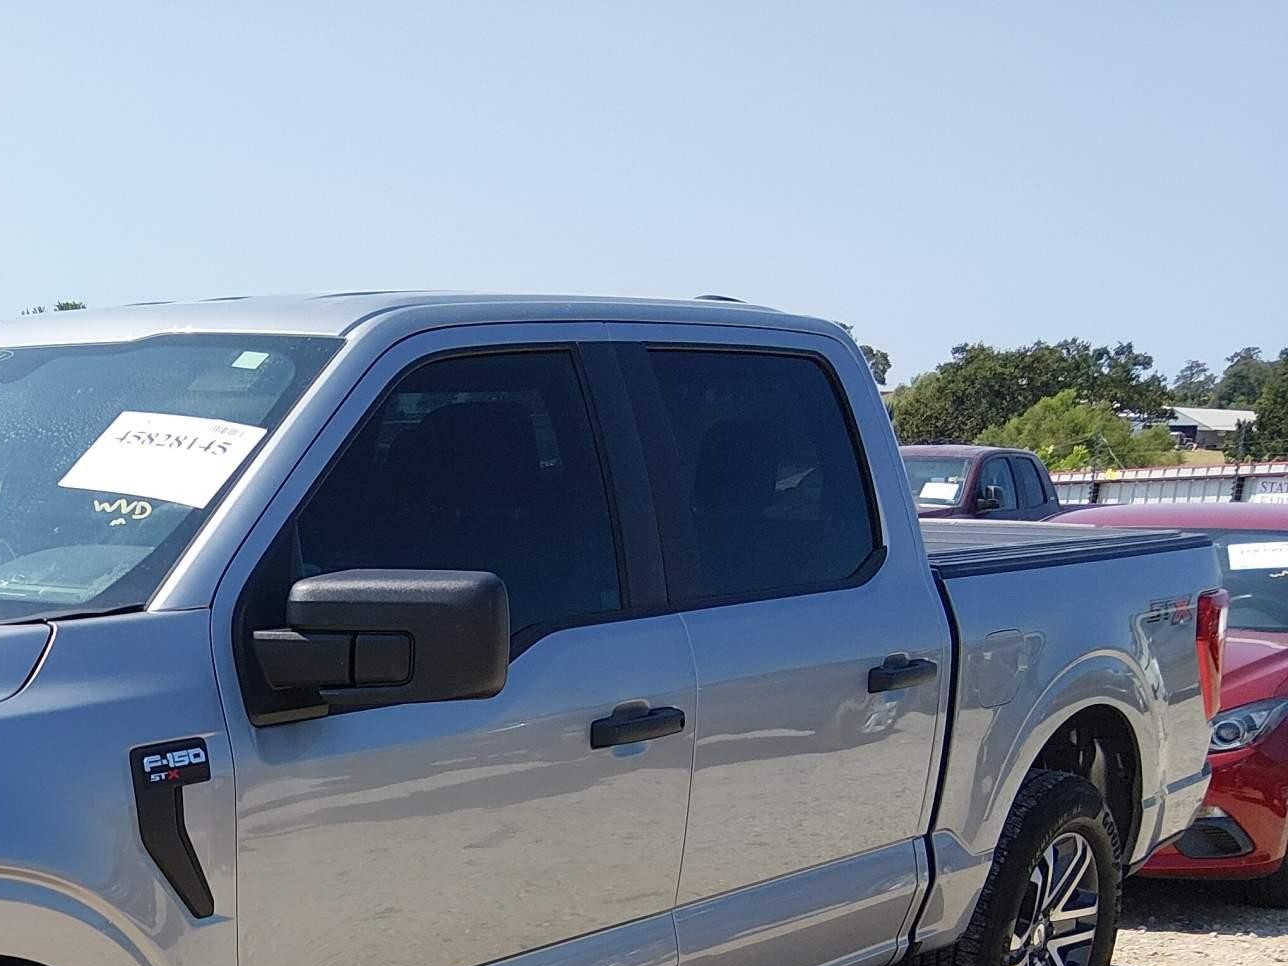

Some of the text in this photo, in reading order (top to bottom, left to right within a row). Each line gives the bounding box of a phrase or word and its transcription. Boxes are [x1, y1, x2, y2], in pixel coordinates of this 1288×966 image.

[114, 430, 232, 455] 45828145
[1146, 596, 1193, 625] STX
[143, 747, 206, 772] F-150
[150, 769, 180, 782] STX
